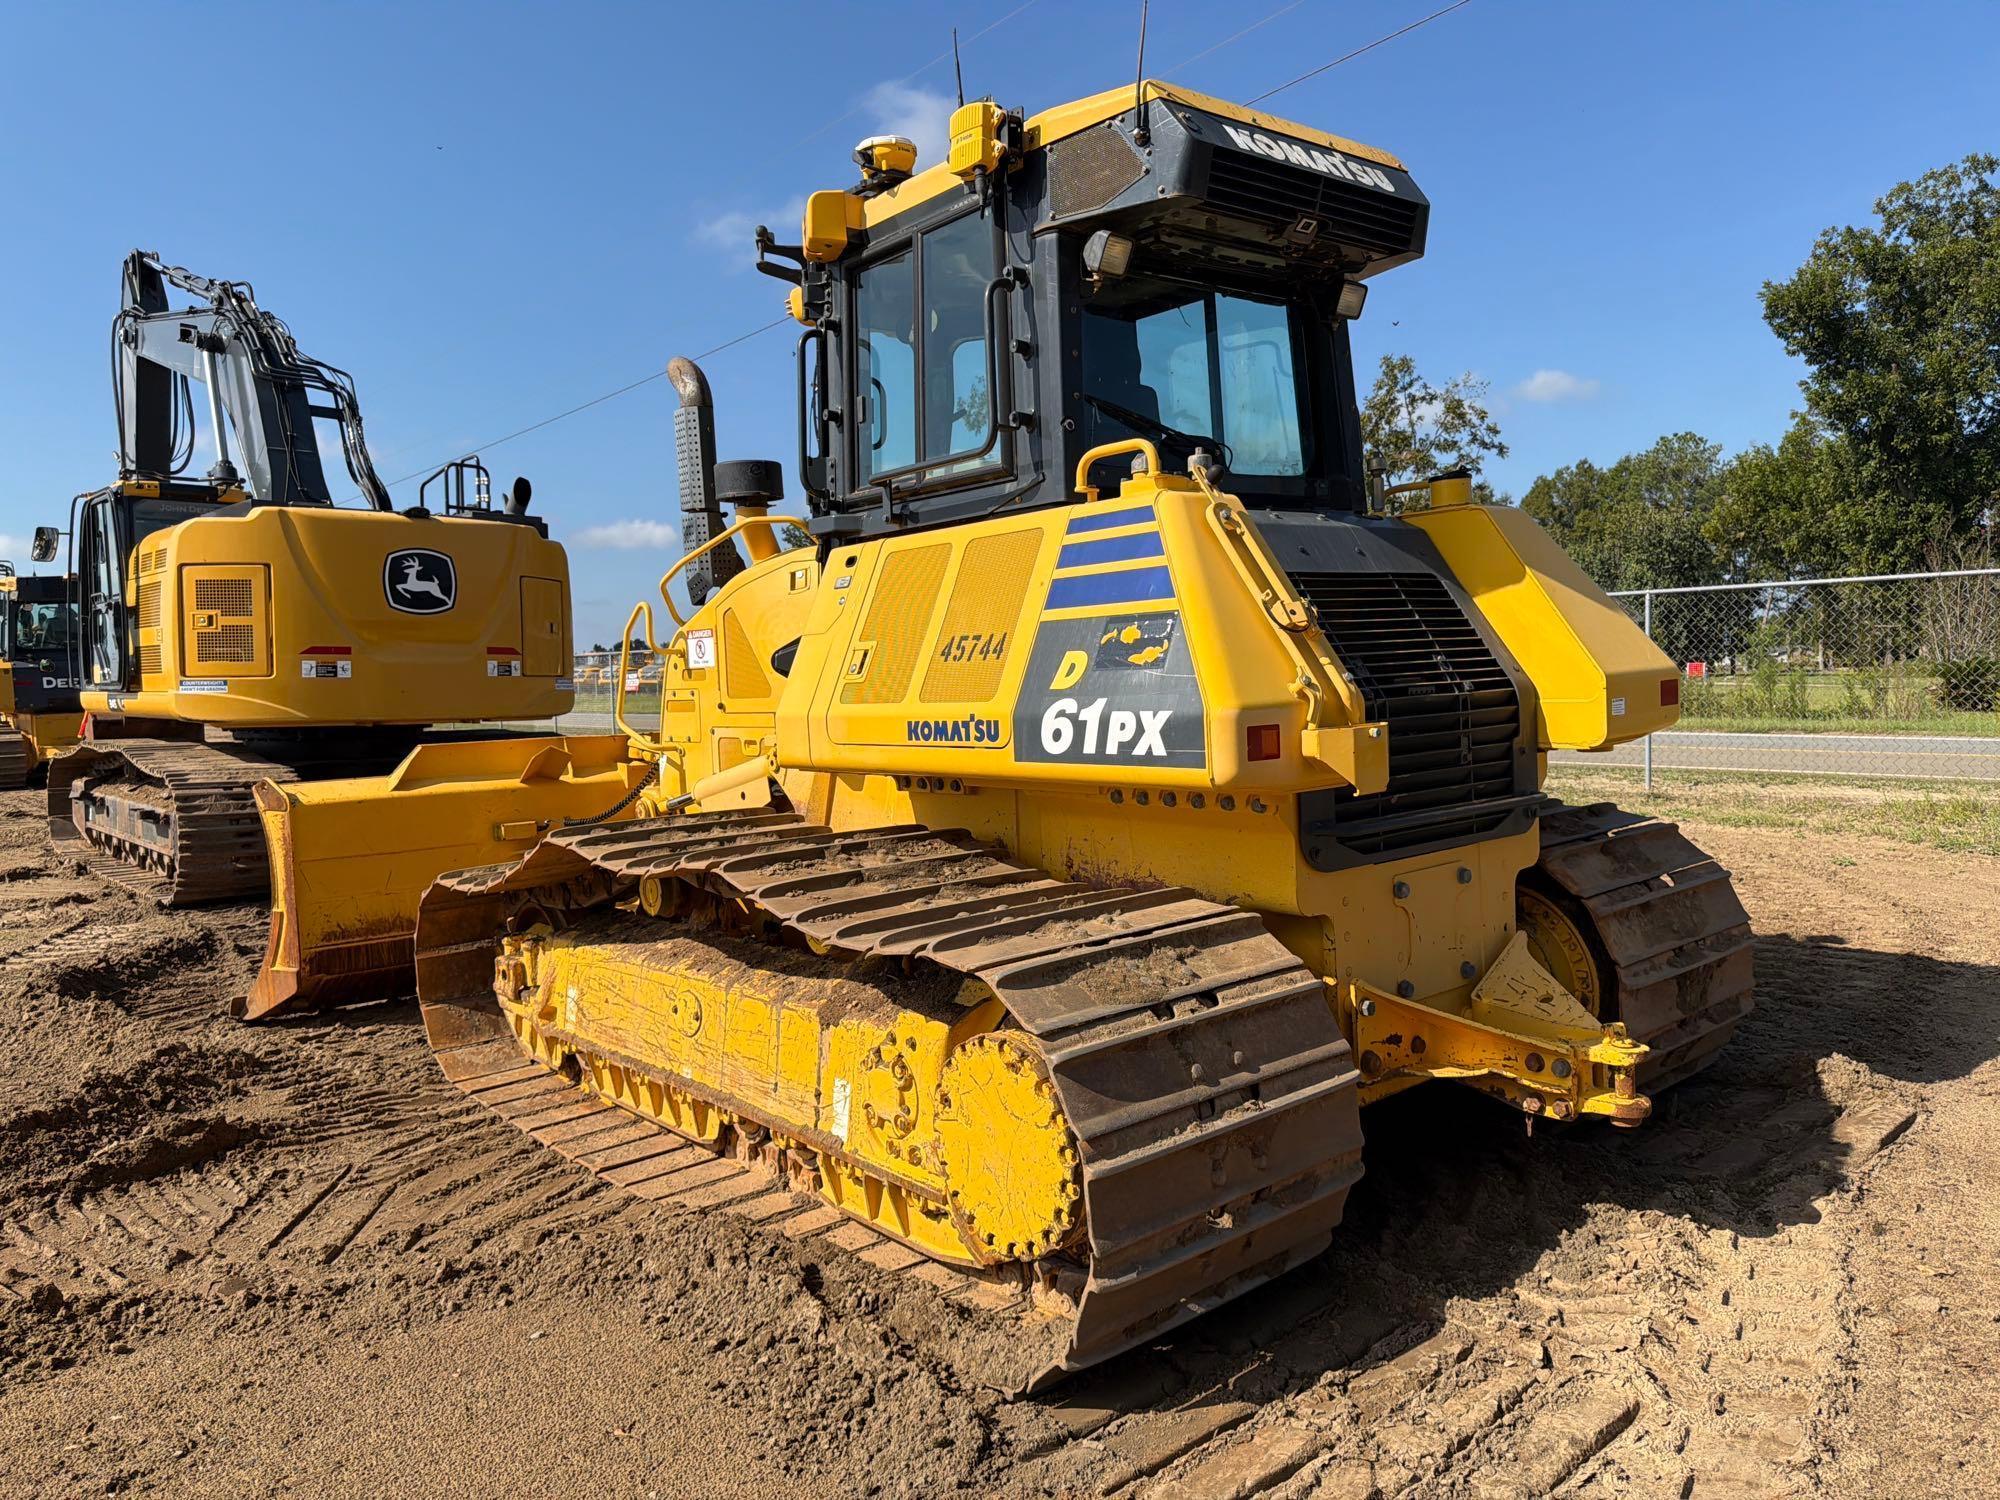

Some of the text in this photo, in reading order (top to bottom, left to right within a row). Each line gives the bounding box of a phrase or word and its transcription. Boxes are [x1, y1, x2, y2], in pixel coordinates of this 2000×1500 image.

[1222, 124, 1395, 192] KOMATSU
[160, 504, 187, 513] JOHN
[941, 632, 1007, 662] 45744
[1049, 650, 1088, 690] D
[907, 714, 1000, 742] KOMATSU
[1041, 697, 1173, 756] 61PX
